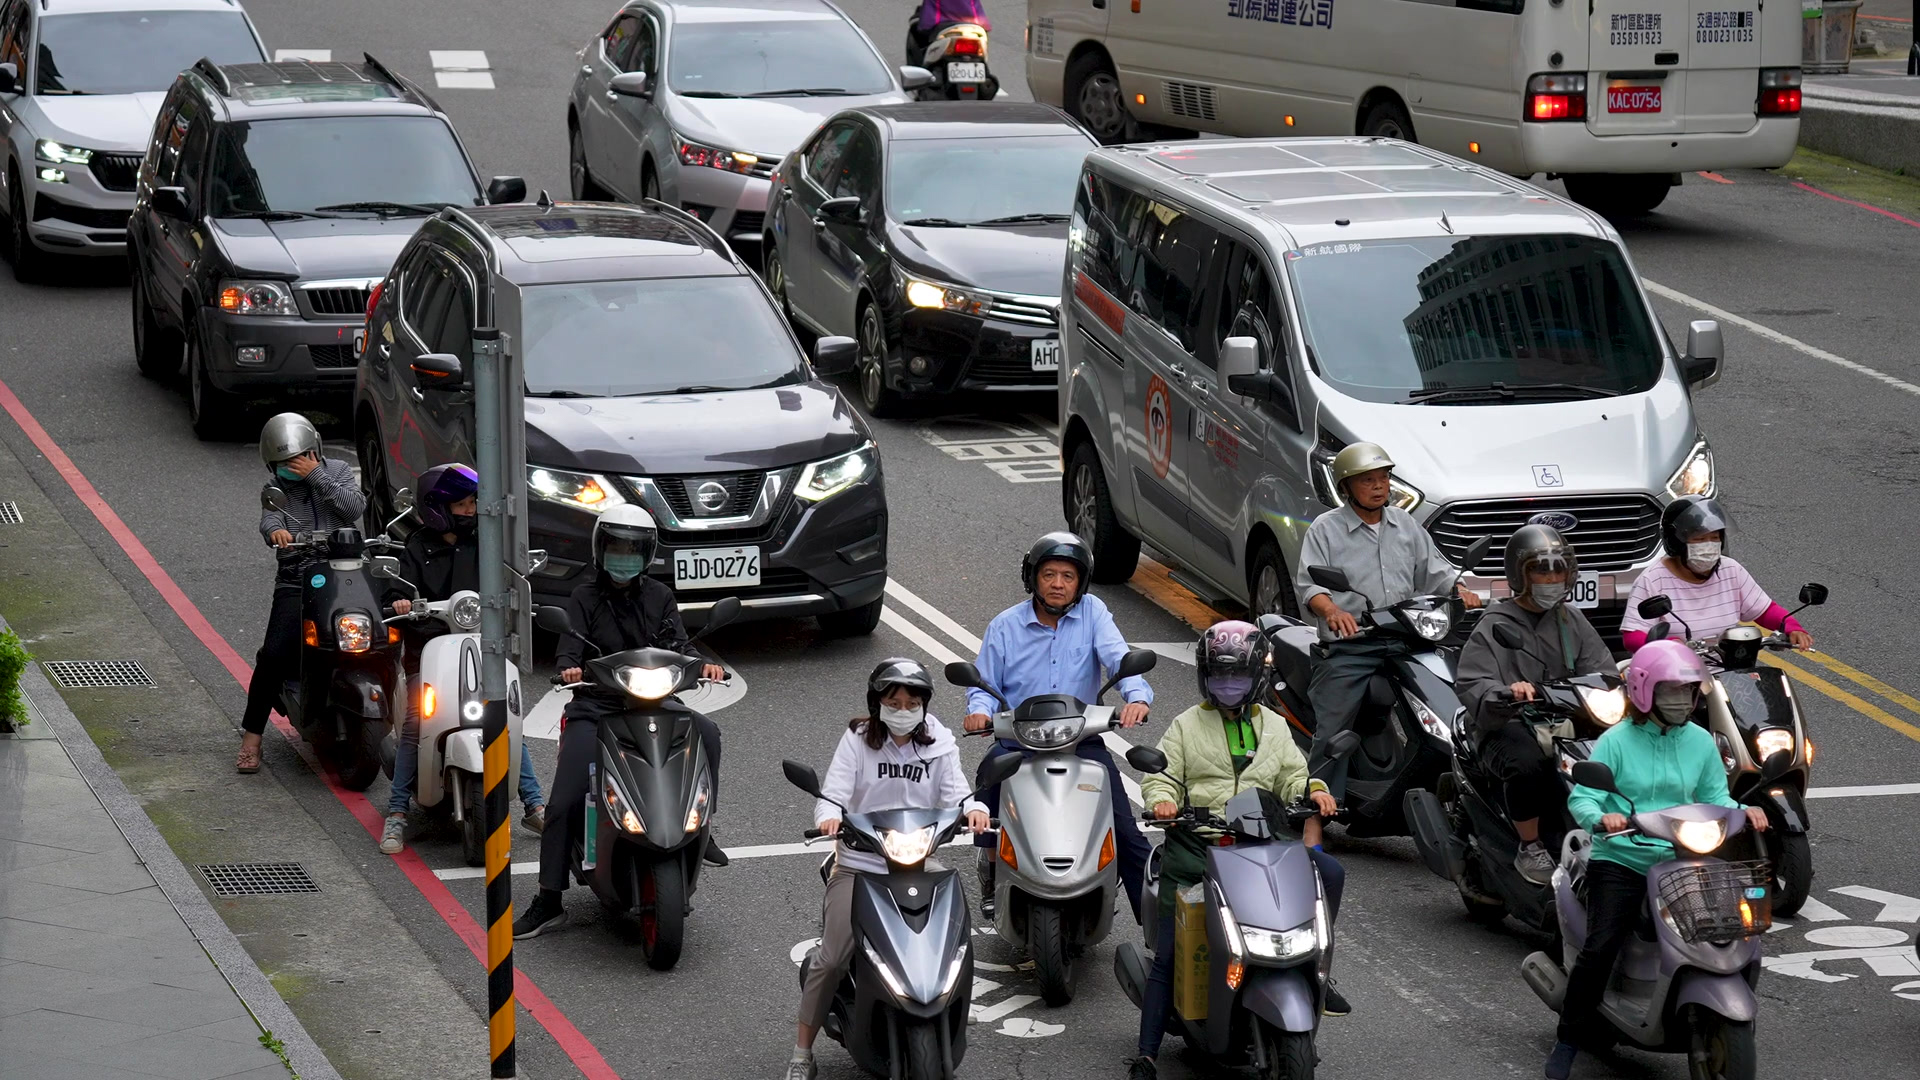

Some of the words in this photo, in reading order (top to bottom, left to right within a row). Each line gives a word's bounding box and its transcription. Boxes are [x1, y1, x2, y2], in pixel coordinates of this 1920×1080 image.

[1611, 13, 1662, 31] 新竹區監理所
[1697, 11, 1753, 29] 交通部公路局
[1610, 31, 1662, 46] 035891923
[1696, 29, 1753, 44] 0800231035
[1540, 514, 1568, 528] Ford
